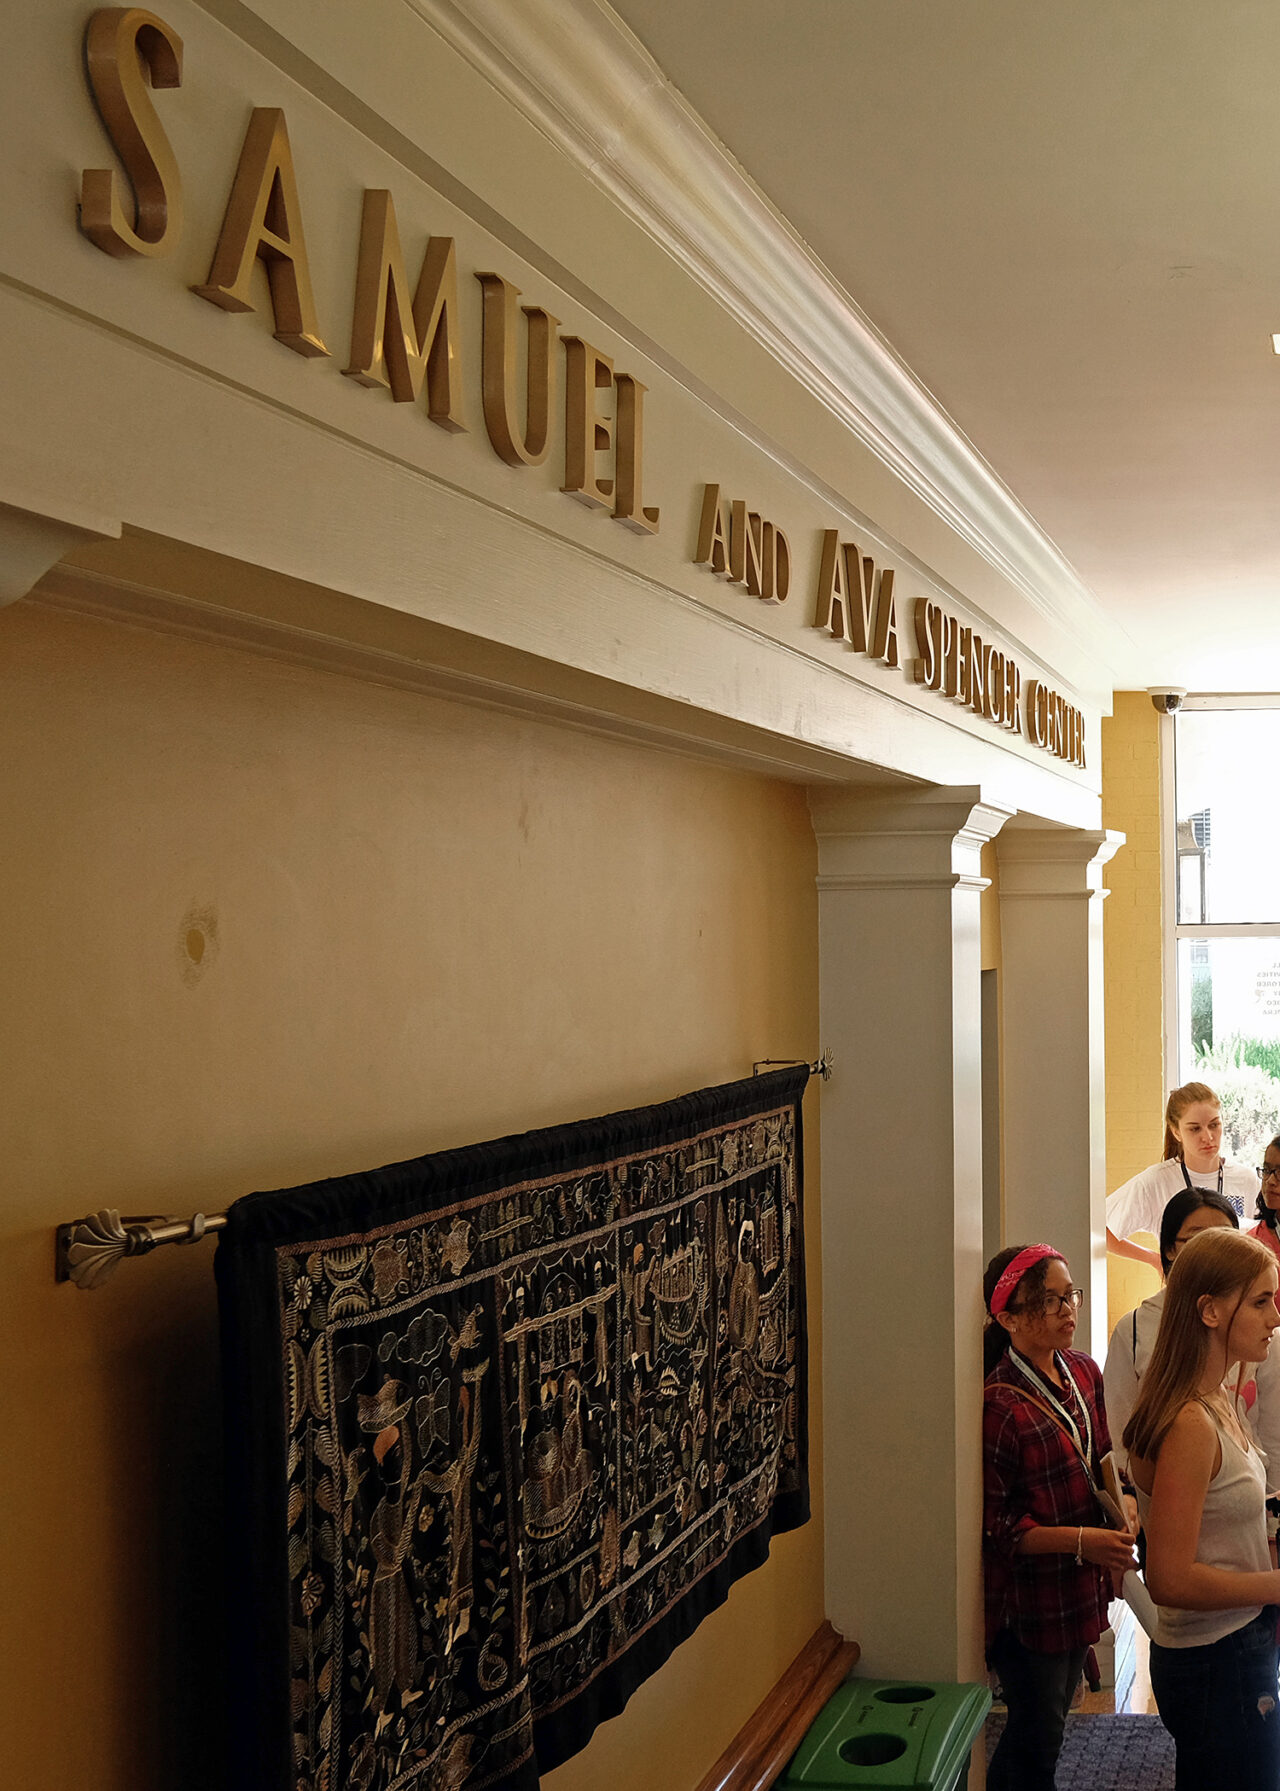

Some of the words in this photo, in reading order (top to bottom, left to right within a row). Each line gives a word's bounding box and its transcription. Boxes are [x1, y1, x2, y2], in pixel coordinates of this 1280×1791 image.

[79, 7, 659, 535] SAMUEL
[693, 484, 792, 606] AND
[811, 529, 903, 671] AVA
[914, 597, 1024, 736] SPENCER
[1026, 680, 1086, 770] CENTER
